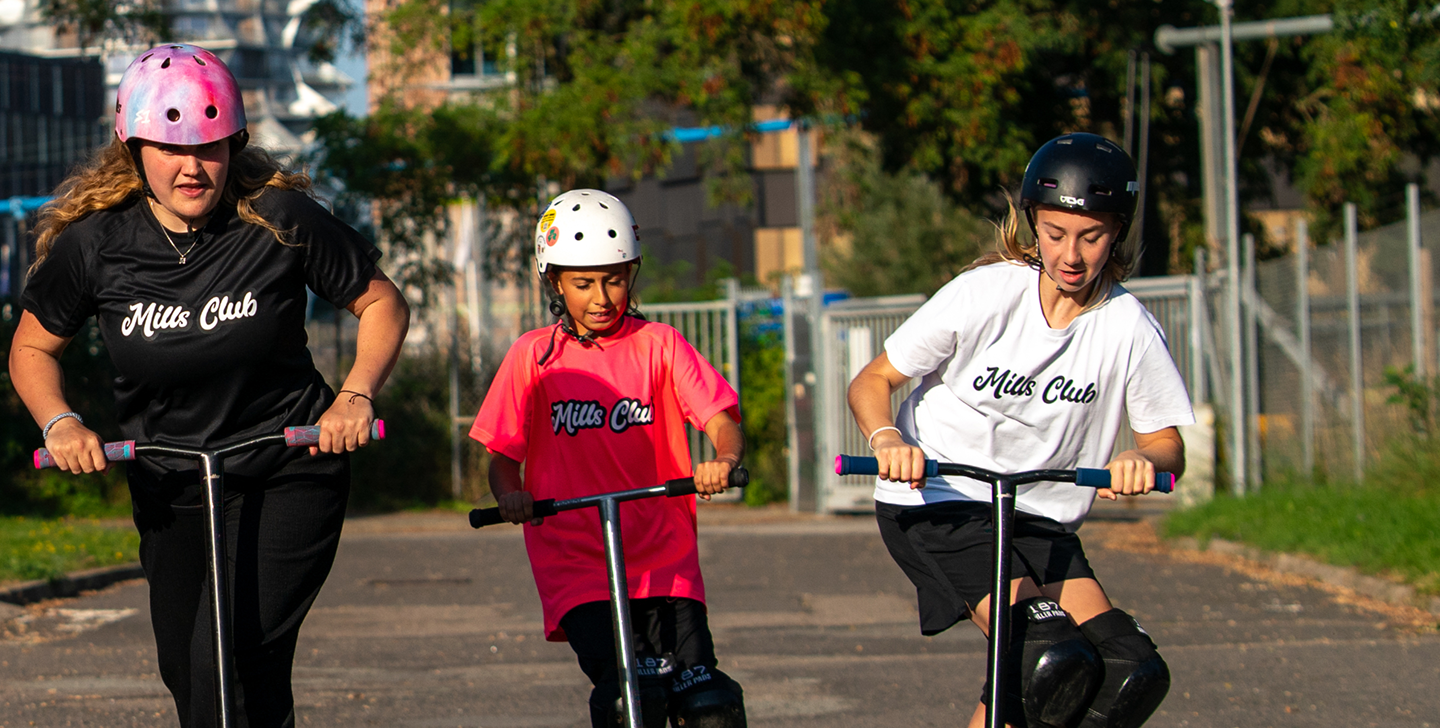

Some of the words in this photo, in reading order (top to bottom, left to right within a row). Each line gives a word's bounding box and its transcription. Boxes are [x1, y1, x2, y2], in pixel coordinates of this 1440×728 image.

[120, 301, 192, 338] Mills
[199, 291, 259, 331] Club
[972, 365, 1037, 399] Mills
[1041, 374, 1098, 405] Club
[550, 401, 604, 434] Mills
[1029, 601, 1059, 614] 187
[636, 657, 667, 668] 187
[637, 666, 657, 676] ILLER
[672, 665, 707, 687] 187
